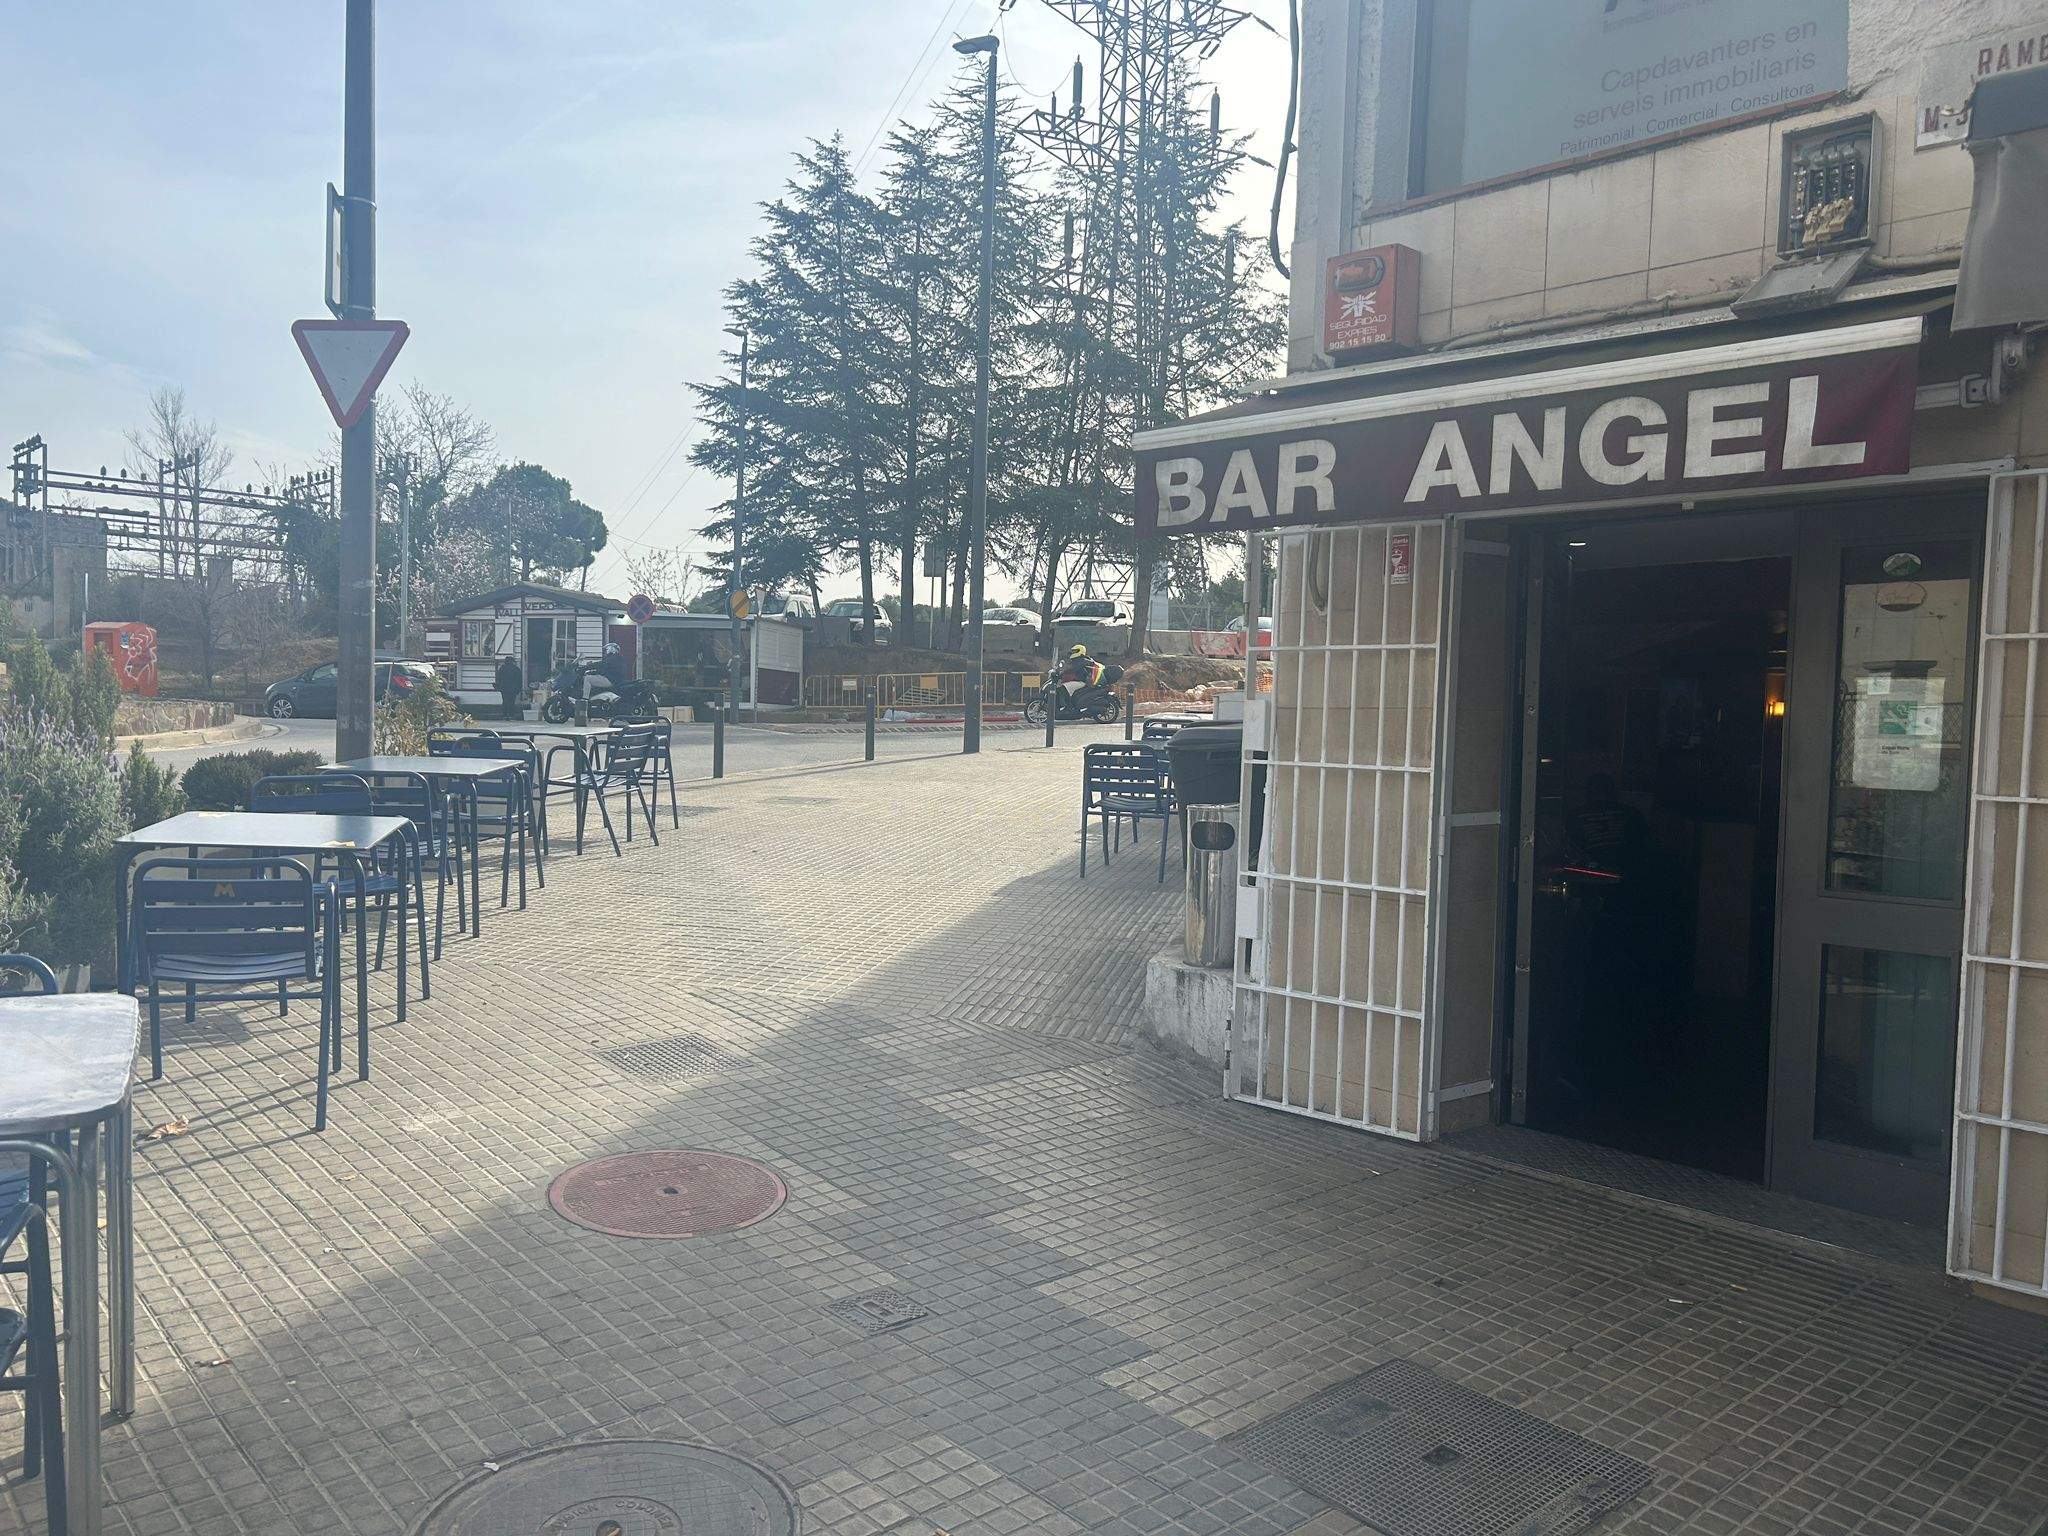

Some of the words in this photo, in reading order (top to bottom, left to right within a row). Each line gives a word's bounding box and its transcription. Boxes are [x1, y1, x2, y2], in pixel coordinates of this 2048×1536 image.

[1573, 93, 1655, 129] serveis
[1663, 50, 1816, 106] immobiliaris
[1601, 32, 1776, 93] Capdavanters
[1784, 21, 1818, 44] en
[1560, 126, 1634, 156] Patrimonial
[1646, 104, 1718, 133] Comercial
[1730, 83, 1815, 113] Consultora
[1329, 314, 1387, 331] SEGURIDAD
[1329, 341, 1345, 350] 902
[1374, 333, 1386, 342] 20
[1155, 438, 1337, 528] BAR
[1404, 374, 1867, 503] ANGEL
